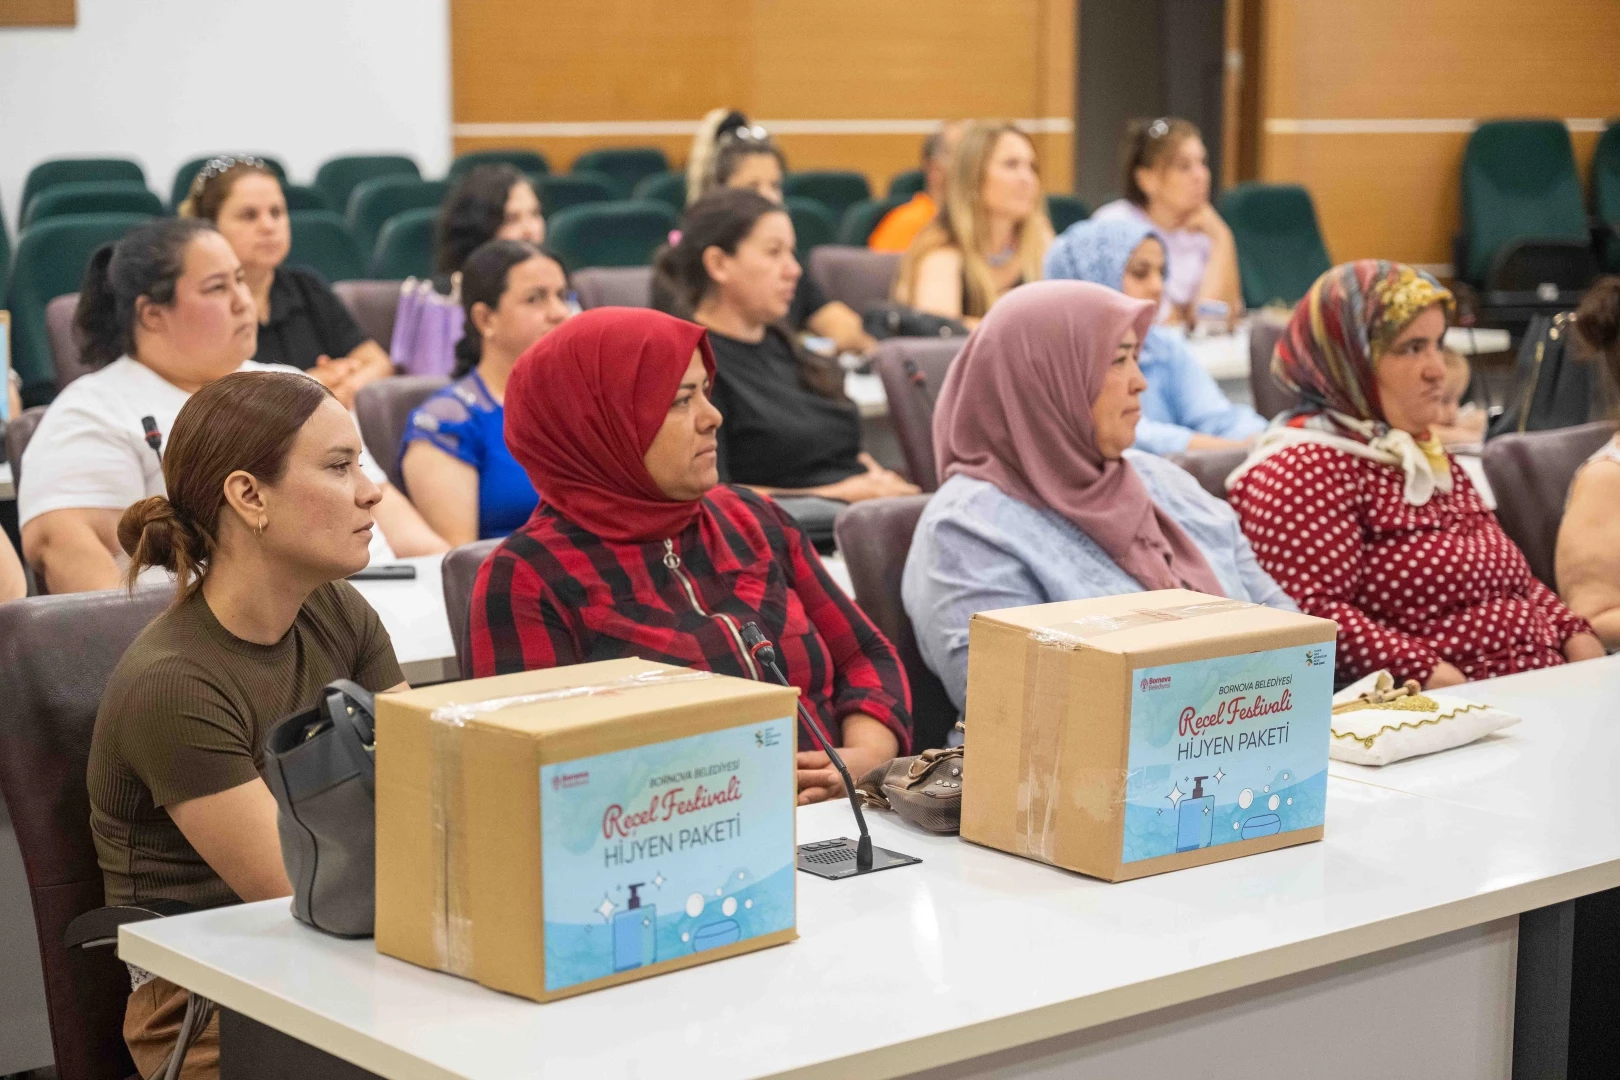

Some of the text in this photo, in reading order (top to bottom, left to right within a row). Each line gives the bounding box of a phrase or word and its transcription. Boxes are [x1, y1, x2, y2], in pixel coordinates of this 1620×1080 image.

[1149, 676, 1171, 685] Bornova
[1218, 674, 1293, 695] BORNOVA BELEDİYESİ
[1178, 689, 1293, 736] Reçel Festivali
[1178, 722, 1290, 760] HİJYEN PAKETİ
[649, 771, 692, 788] BORNOVA
[602, 775, 743, 839] Reçel Festivali
[604, 812, 741, 868] HİJYEN PAKETİ
